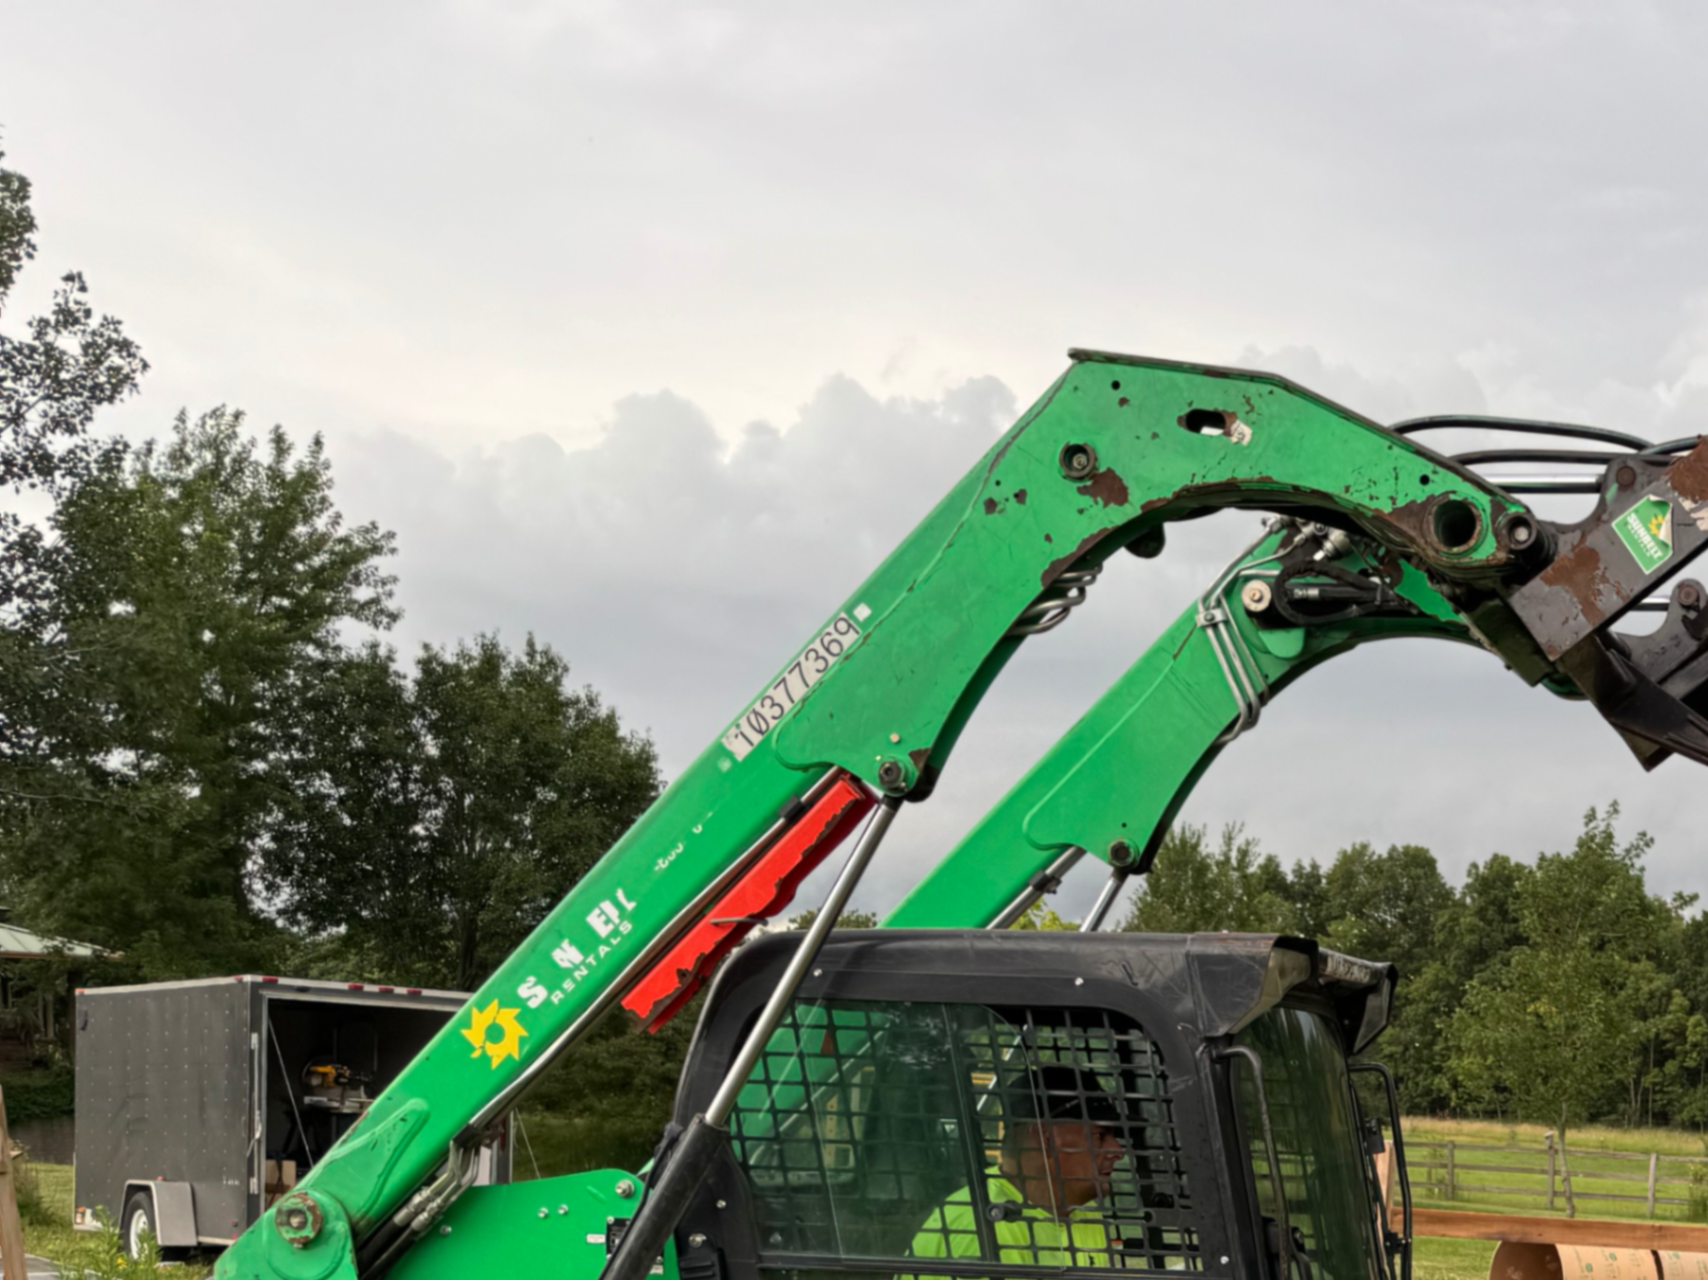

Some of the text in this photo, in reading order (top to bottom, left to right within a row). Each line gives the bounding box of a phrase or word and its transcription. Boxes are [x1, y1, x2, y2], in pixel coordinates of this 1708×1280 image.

[1626, 512, 1663, 559] SUNBELT
[734, 616, 861, 748] 10377369
[550, 920, 633, 1005] RENTALS
